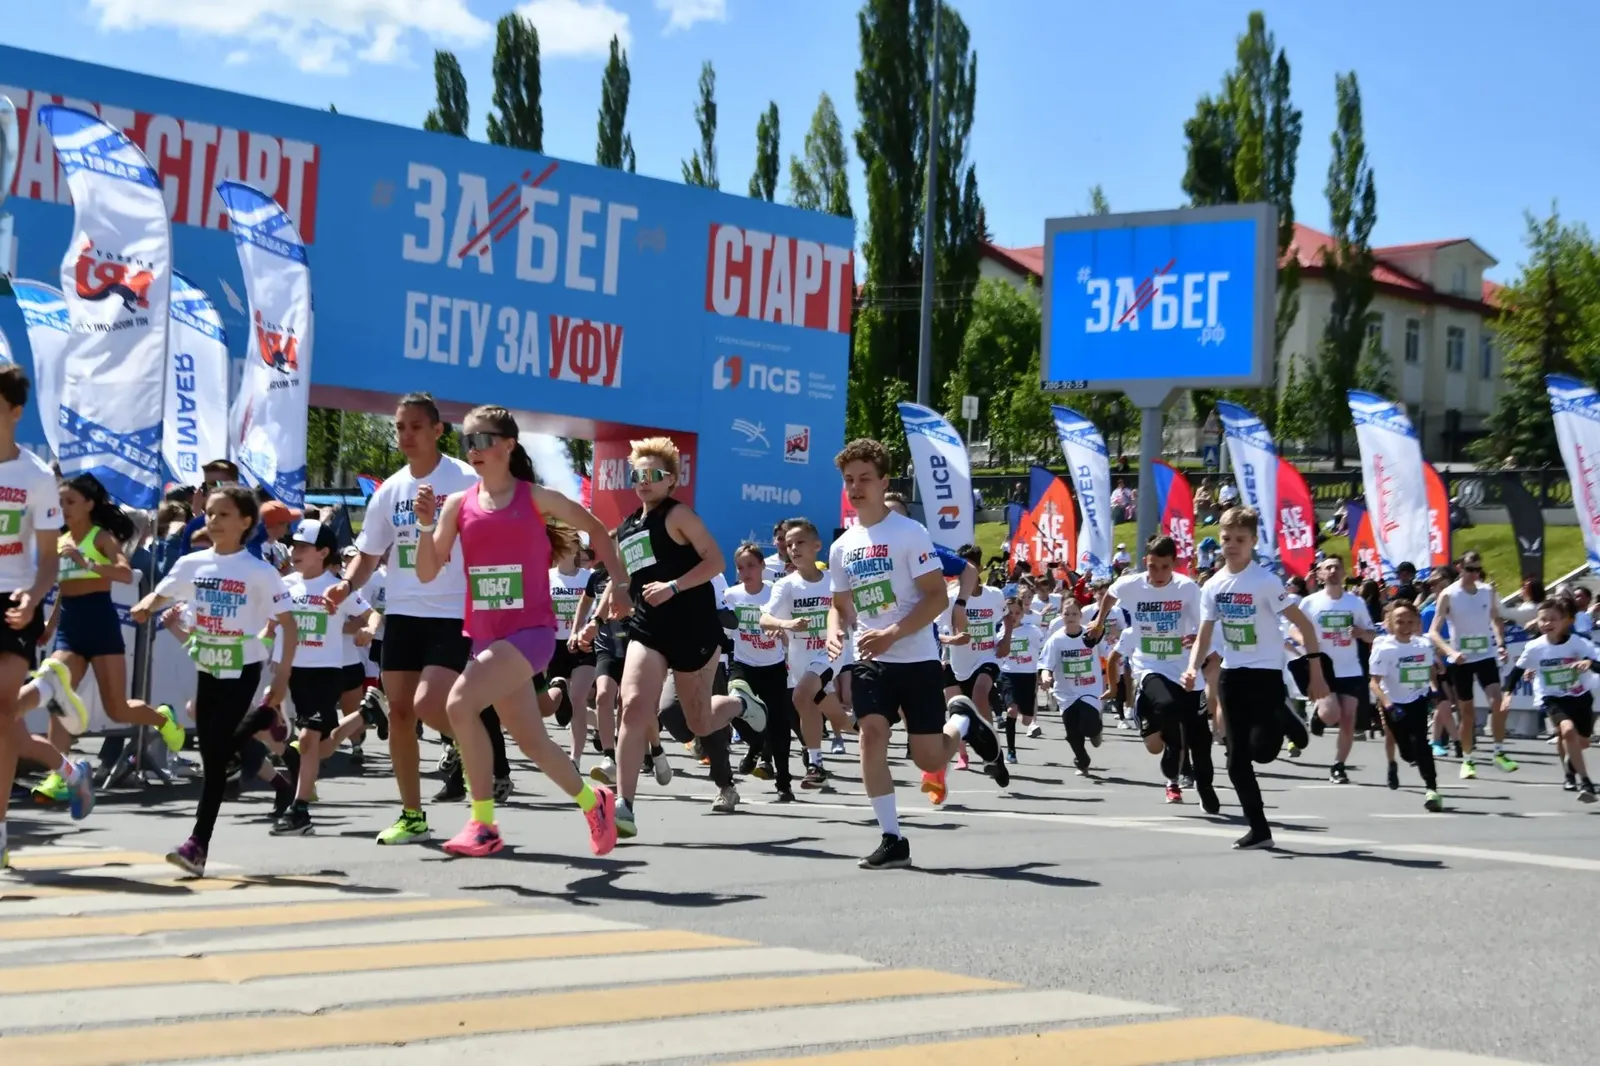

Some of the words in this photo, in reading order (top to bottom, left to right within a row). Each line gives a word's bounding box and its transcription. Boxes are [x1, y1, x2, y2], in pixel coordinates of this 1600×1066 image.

[711, 223, 850, 334] СТАРТ
[404, 290, 492, 368] БЕГУ
[496, 306, 541, 377] ЗА
[548, 314, 624, 388] УФУ
[748, 363, 801, 395] ПСБ
[477, 577, 511, 597] 10547
